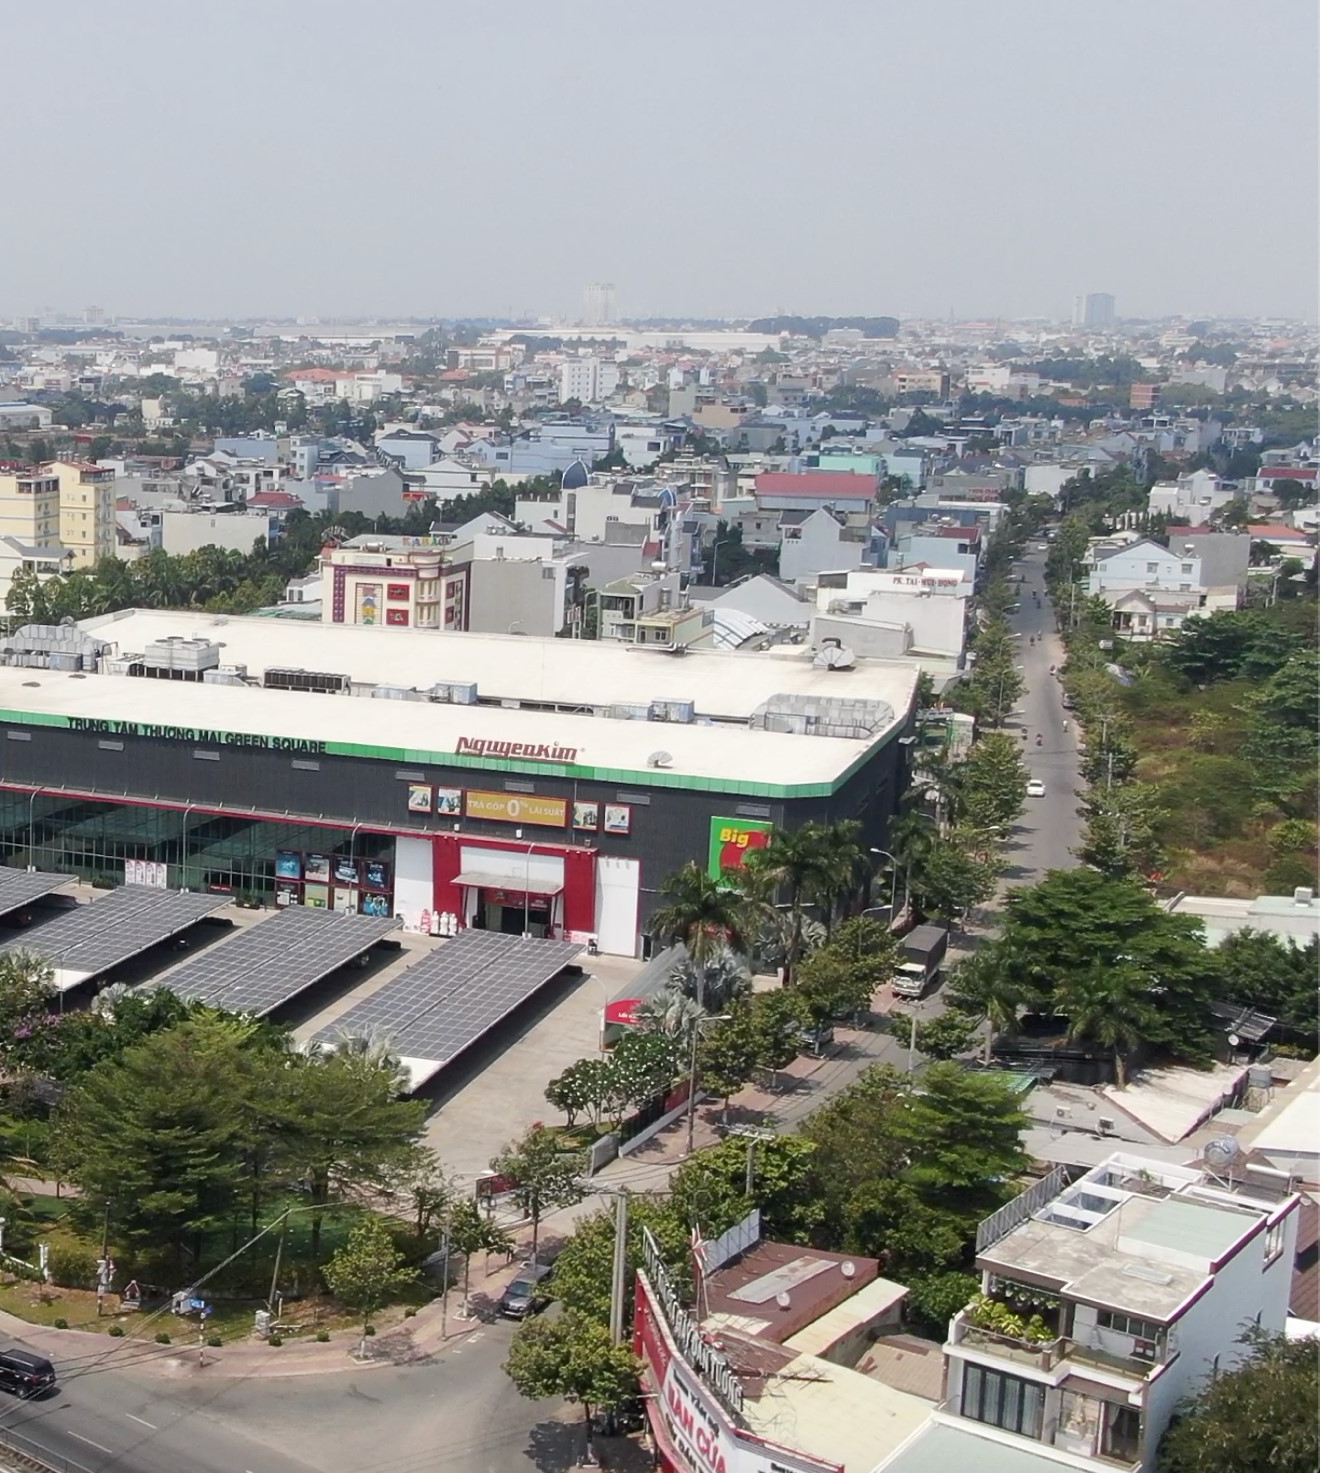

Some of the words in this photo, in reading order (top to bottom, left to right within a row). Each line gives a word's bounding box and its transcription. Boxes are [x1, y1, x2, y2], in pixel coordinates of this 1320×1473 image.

[68, 715, 109, 733] TRUNG
[225, 731, 269, 750] GREEN
[272, 735, 327, 755] SQUARE
[720, 828, 749, 849] Big
